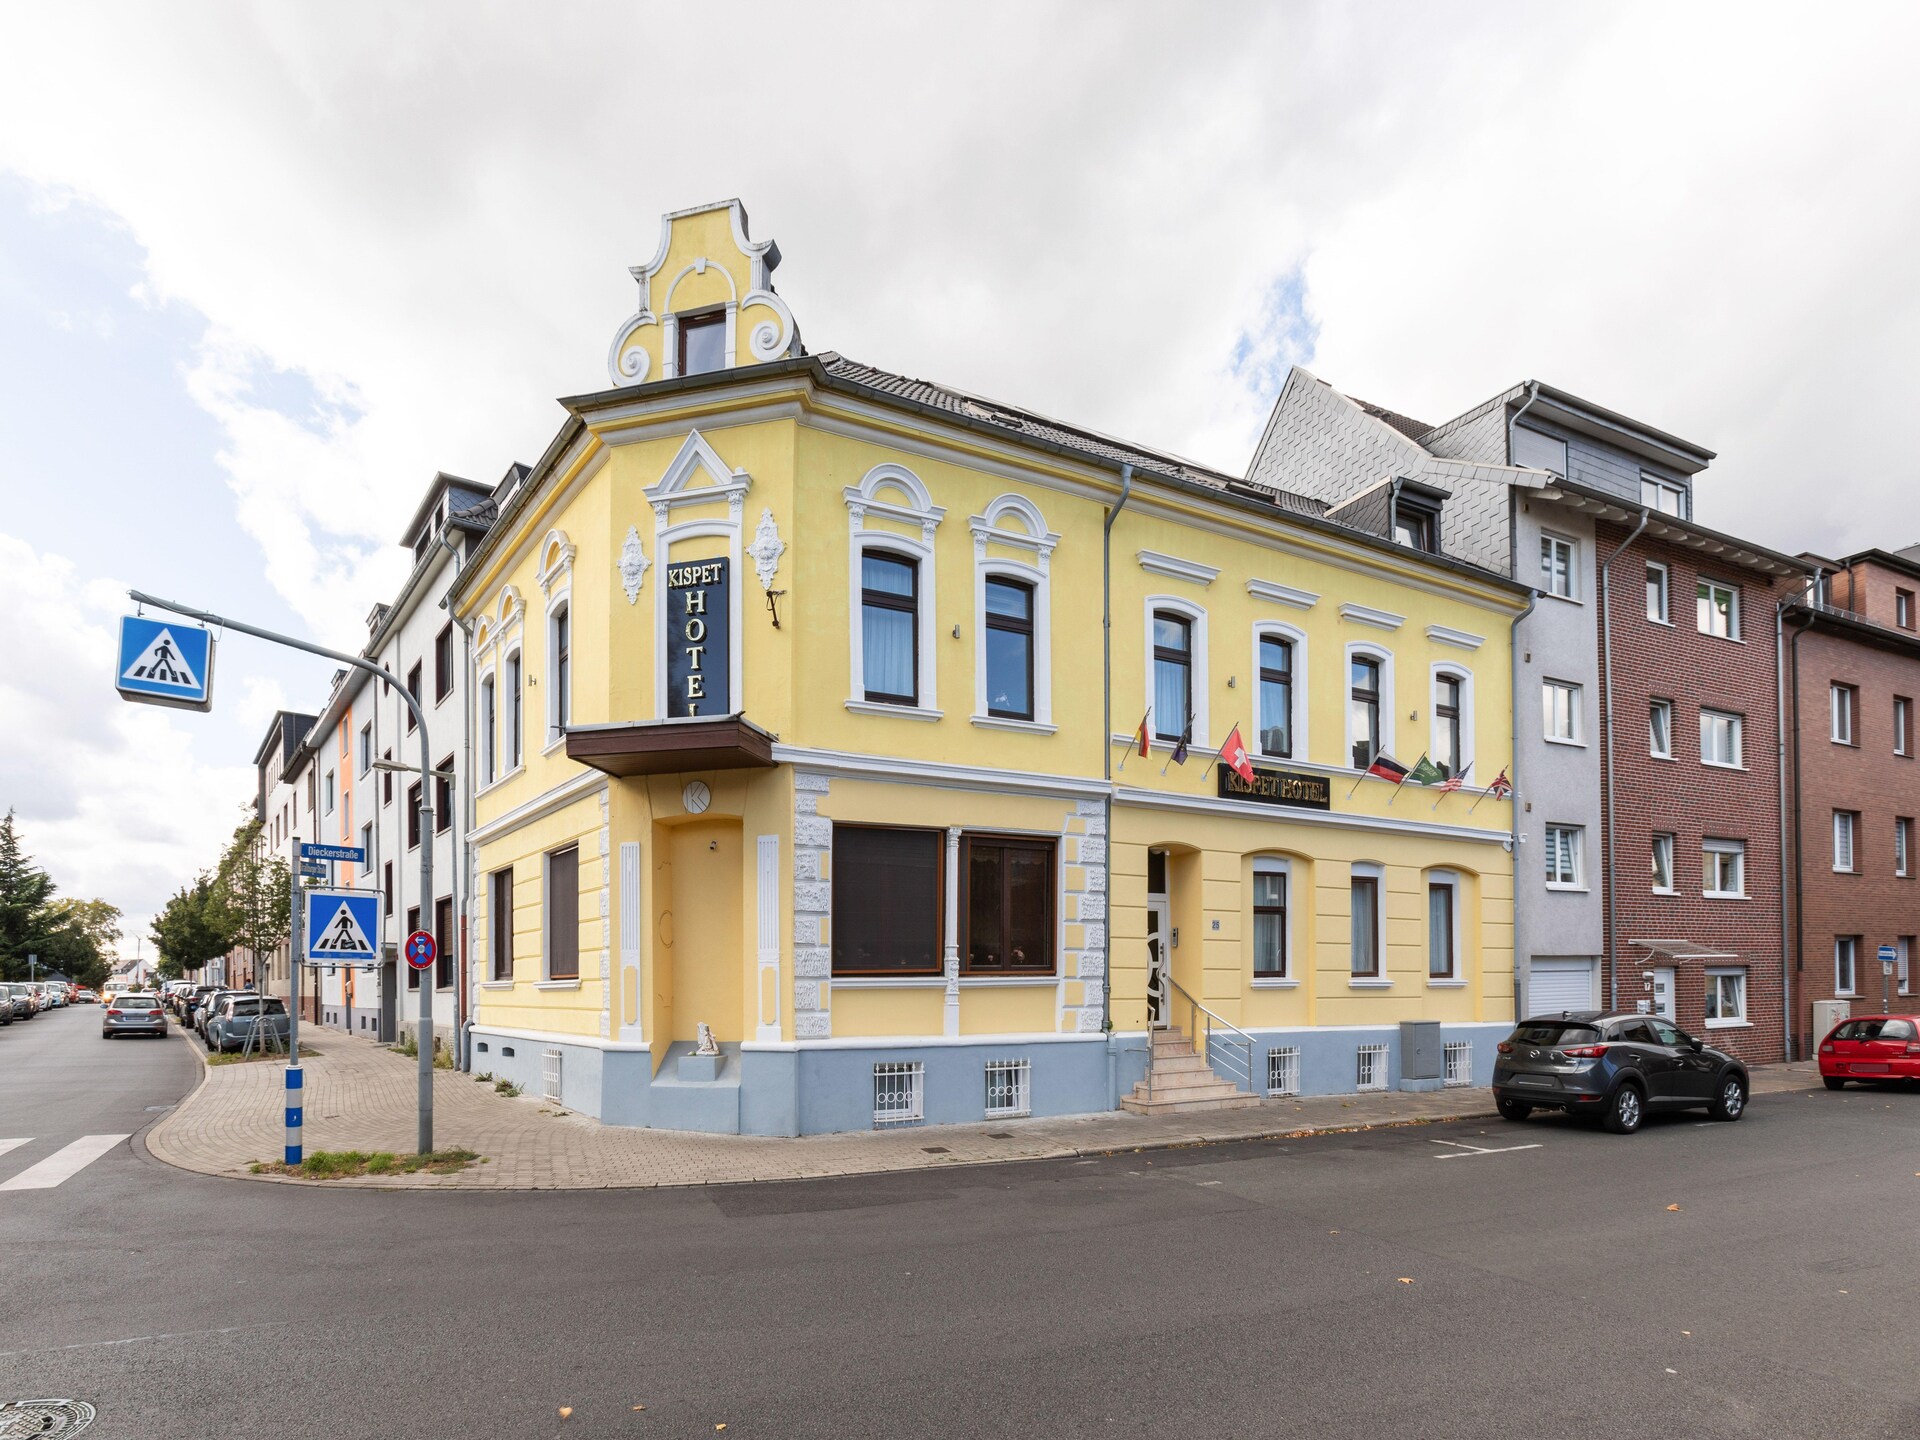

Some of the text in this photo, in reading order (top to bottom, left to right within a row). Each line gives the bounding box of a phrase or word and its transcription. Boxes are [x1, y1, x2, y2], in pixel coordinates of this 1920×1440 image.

[668, 562, 722, 588] KISPET
[1280, 778, 1328, 802] HOTEL
[308, 846, 359, 859] Dieckerstraße
[1644, 982, 1651, 991] 17
